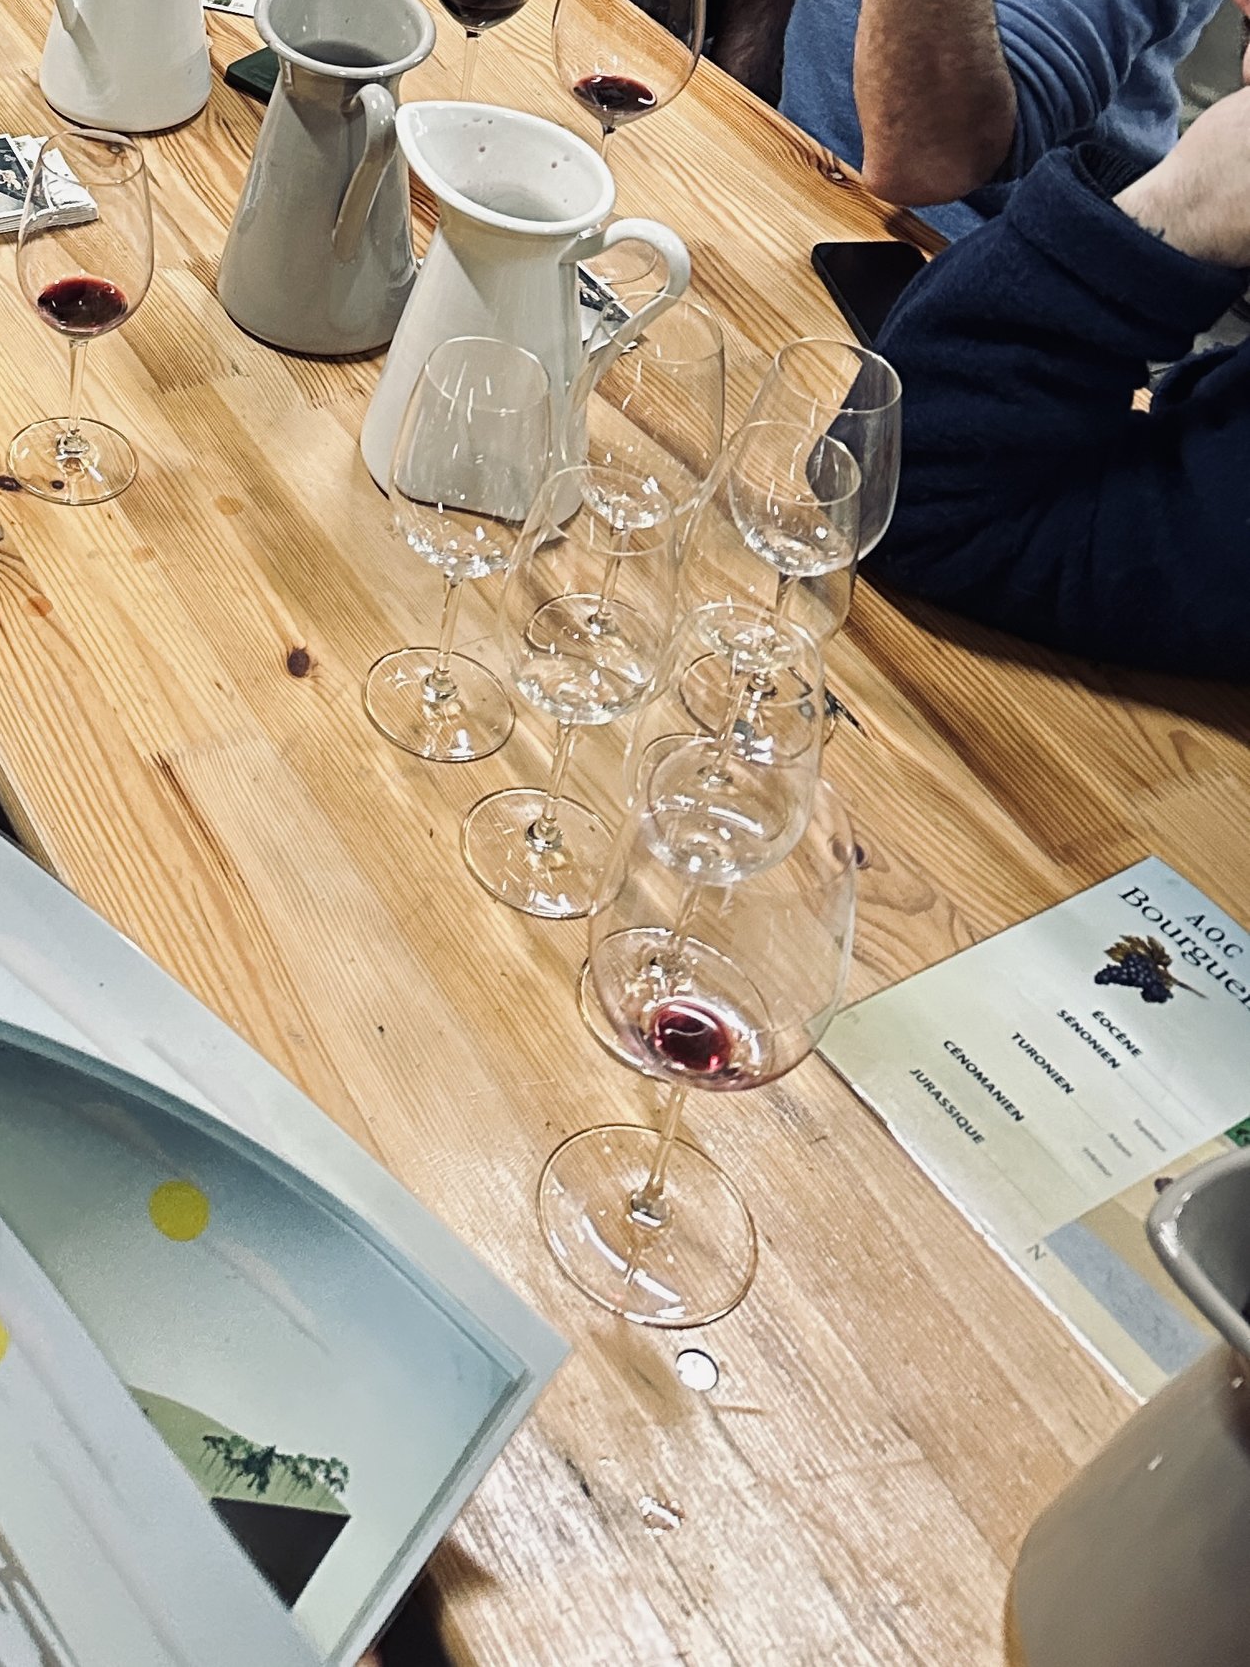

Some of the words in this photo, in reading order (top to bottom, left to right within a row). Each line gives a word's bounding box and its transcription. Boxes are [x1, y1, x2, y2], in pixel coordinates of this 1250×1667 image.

[1185, 914, 1243, 959] A.O.C
[1011, 1031, 1075, 1094] TURONIEN
[1056, 1009, 1121, 1069] SÉNONIEN
[909, 1069, 985, 1145] JURASSIQUE
[943, 1040, 1025, 1122] CÉNOMANIEN
